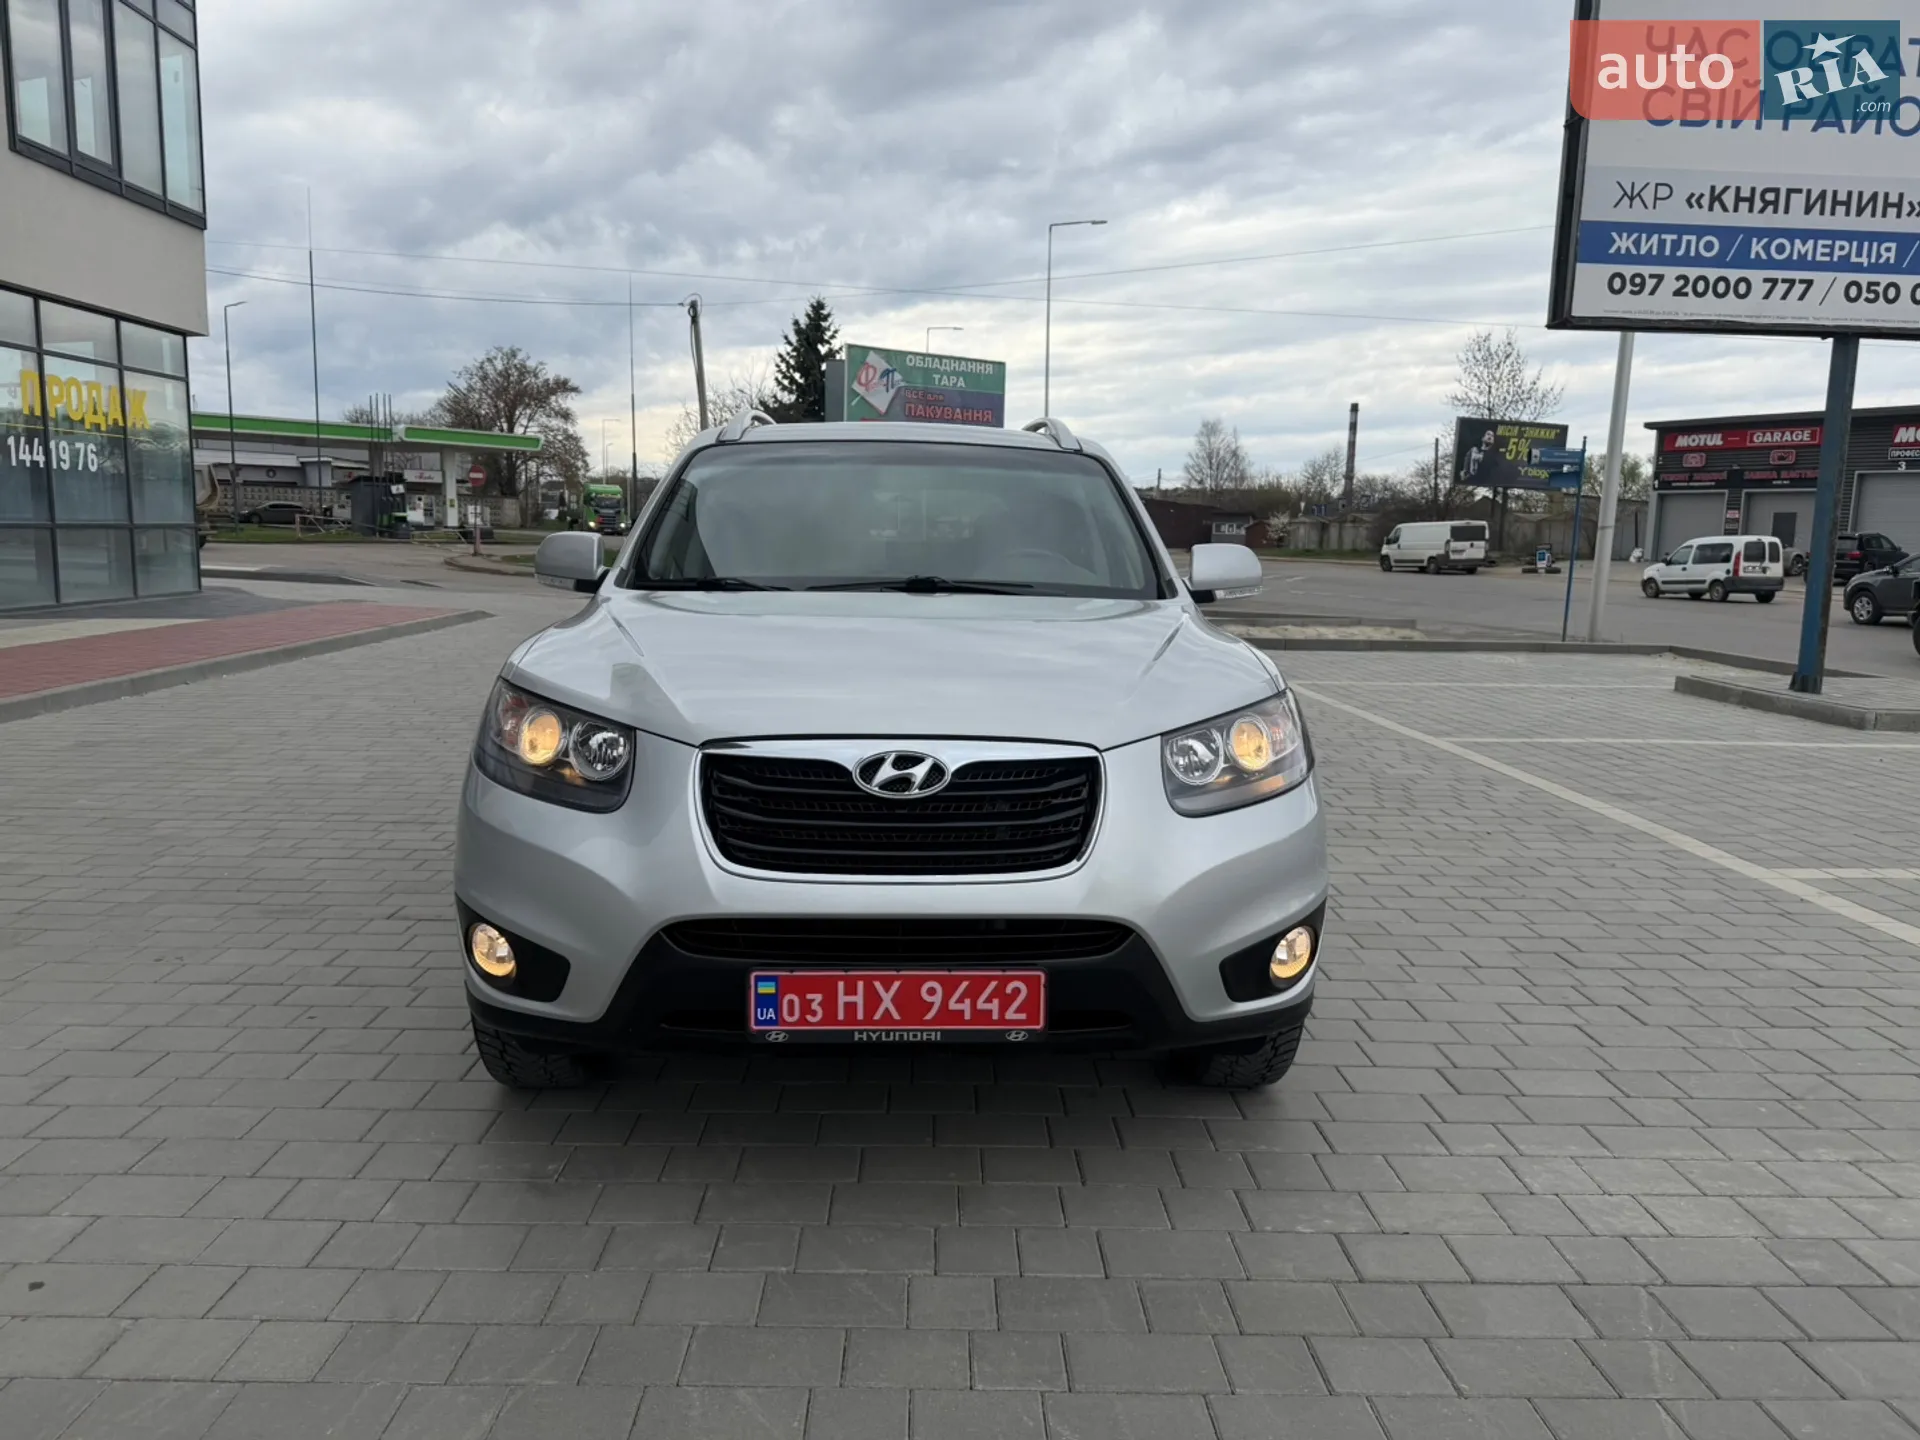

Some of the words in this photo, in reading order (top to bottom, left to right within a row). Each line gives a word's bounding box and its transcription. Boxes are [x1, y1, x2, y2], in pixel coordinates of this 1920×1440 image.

[1613, 180, 1674, 210] ЖР
[1608, 231, 1720, 258] ЖИТЛО
[1750, 237, 1897, 268] КОМЕРЦІЯ
[1607, 271, 1665, 296] 097
[1672, 274, 1752, 300] 2000
[1762, 277, 1814, 302] 777
[1844, 280, 1901, 305] 050
[906, 354, 994, 375] ОБЛАДНАННЯ
[933, 374, 966, 388] ТАРА
[20, 369, 151, 432] ПРОДАЖ
[905, 403, 992, 423] ПАКУВАННЯ
[7, 435, 46, 468] 144
[75, 442, 98, 472] 76
[1675, 433, 1724, 448] MOTUL
[1753, 430, 1812, 443] GARAGE
[757, 1008, 776, 1020] UA
[782, 994, 823, 1023] 03
[837, 980, 902, 1021] HX
[920, 980, 1027, 1021] 9442
[854, 1031, 941, 1042] HYUNDAI
